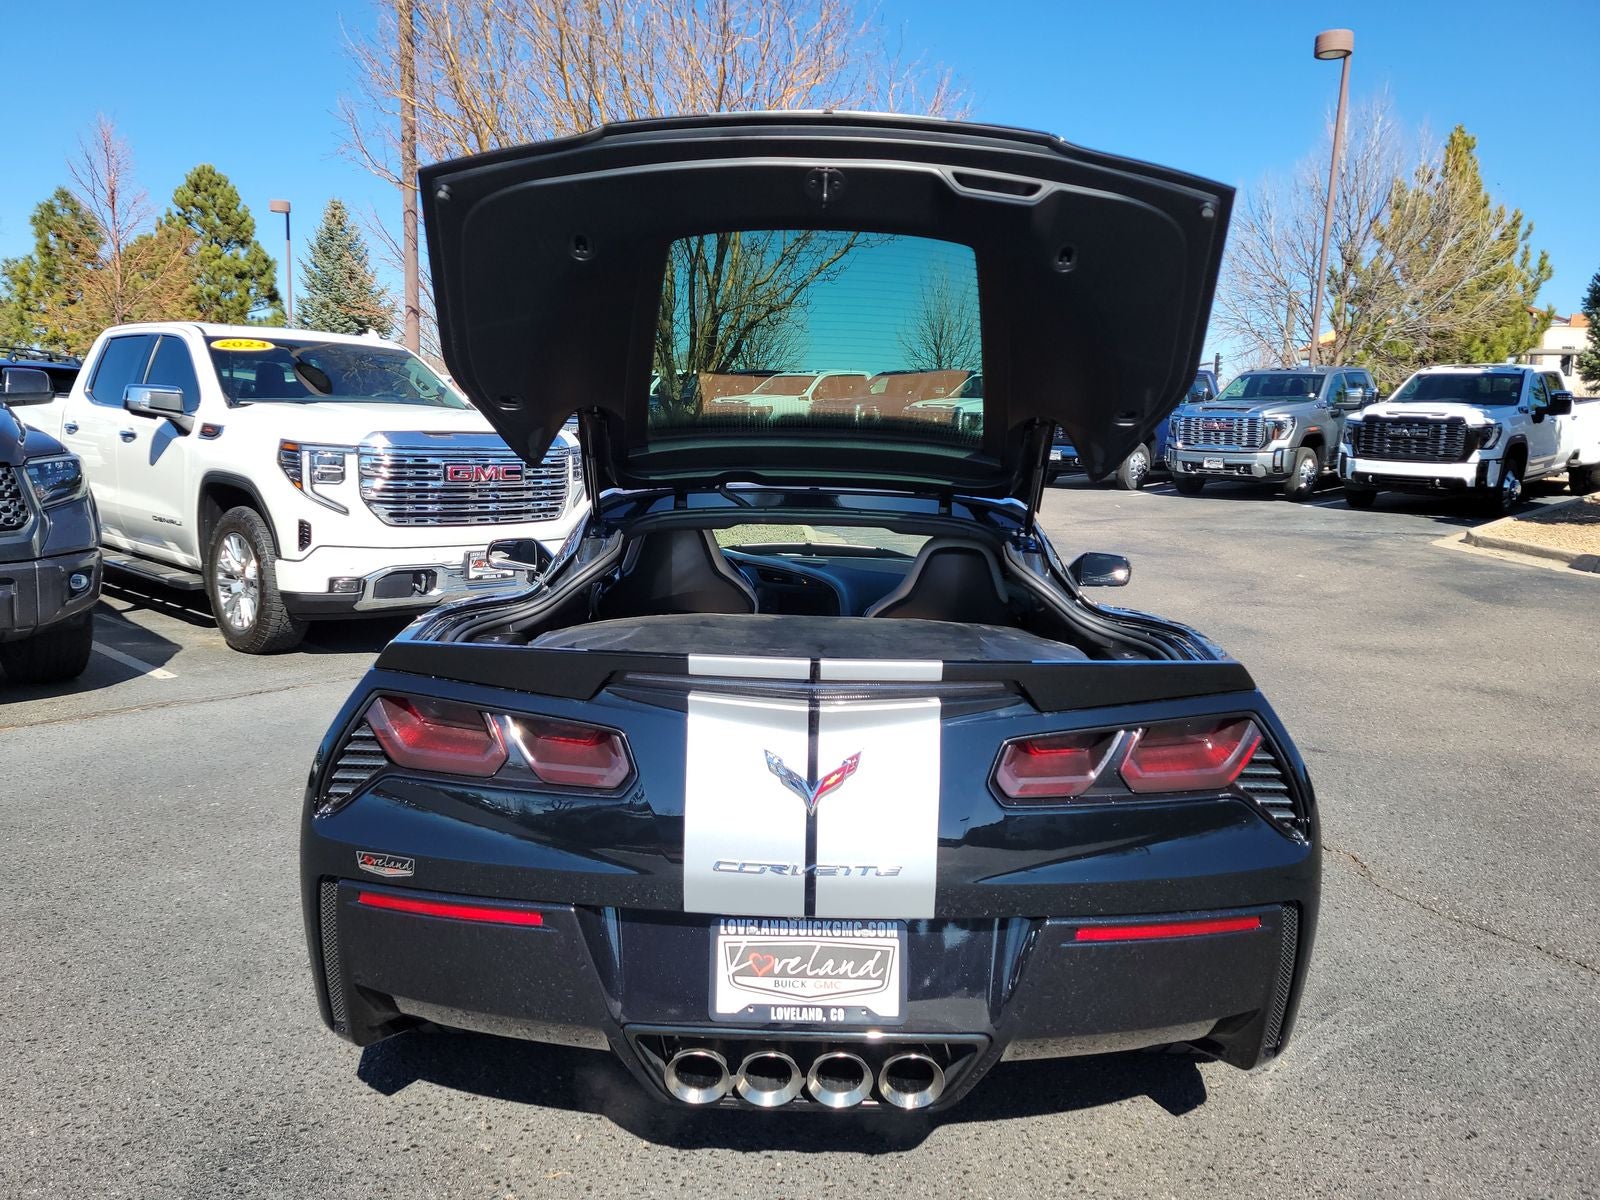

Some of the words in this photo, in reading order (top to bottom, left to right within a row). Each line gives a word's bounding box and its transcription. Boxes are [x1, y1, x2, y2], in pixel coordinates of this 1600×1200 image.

[219, 341, 267, 349] 2024
[447, 464, 522, 481] GMC
[152, 515, 182, 526] DENALI
[713, 860, 903, 877] CORVETTE
[727, 941, 884, 978] Loveland
[774, 980, 807, 989] BUICK
[813, 981, 842, 990] GMC
[770, 1006, 827, 1022] LOVELAND,
[830, 1008, 845, 1022] CO
